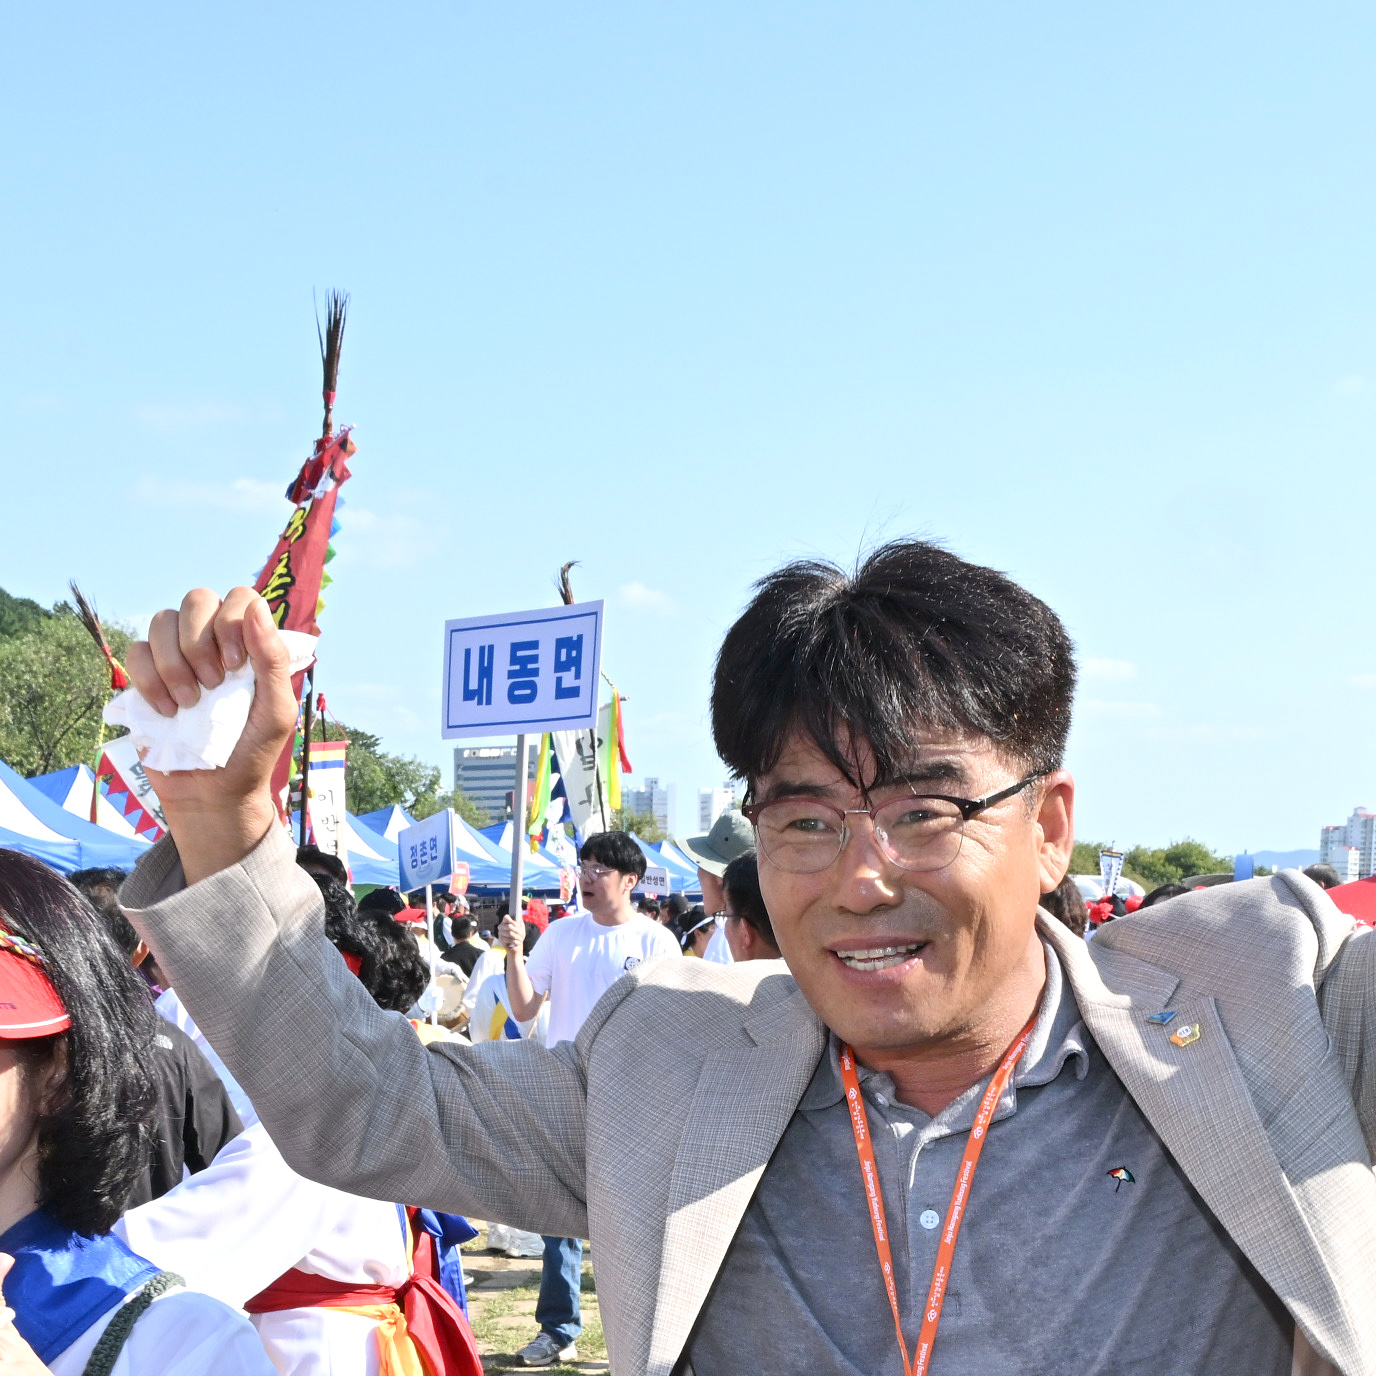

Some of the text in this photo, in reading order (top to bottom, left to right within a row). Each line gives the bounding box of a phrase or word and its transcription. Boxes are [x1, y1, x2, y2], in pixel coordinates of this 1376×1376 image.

[462, 633, 584, 706] 내동면
[409, 834, 438, 870] 정촌면
[943, 1160, 973, 1245] Jinju Namgang Yudeung Festival
[875, 1219, 886, 1241] Festival
[916, 1342, 928, 1365] Festival
